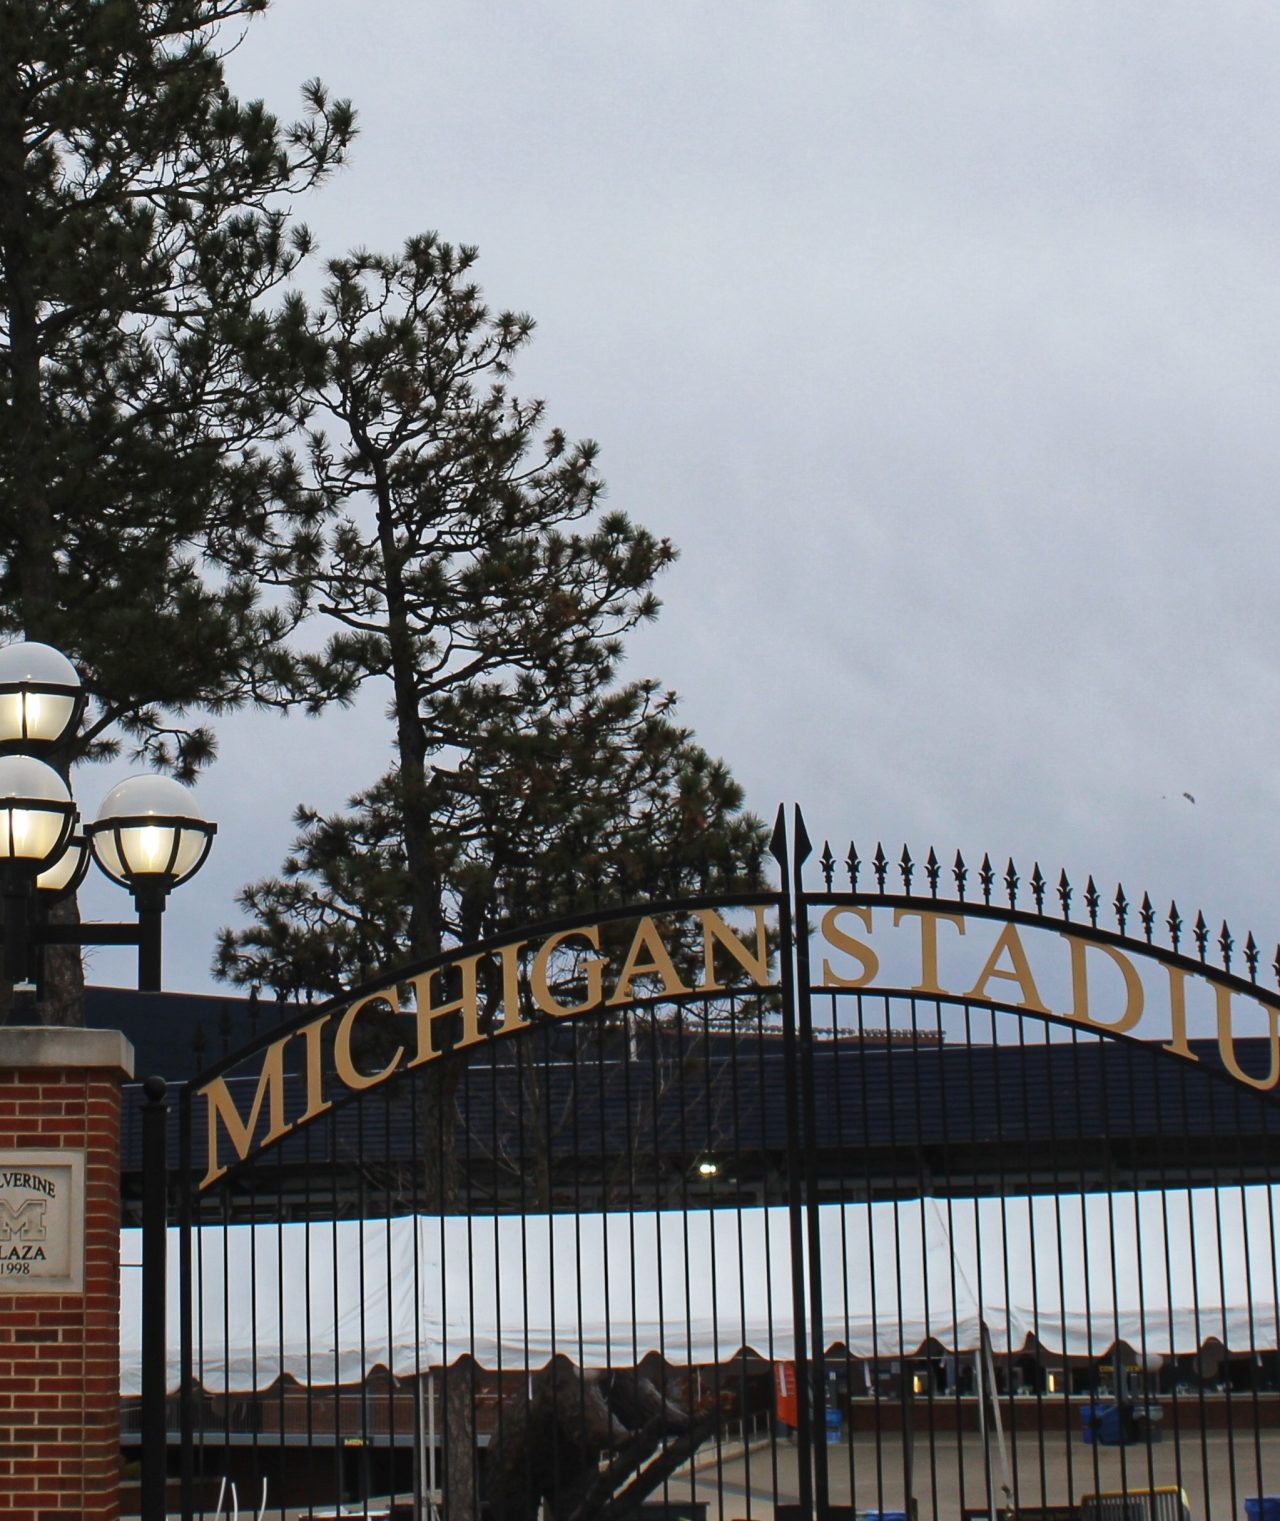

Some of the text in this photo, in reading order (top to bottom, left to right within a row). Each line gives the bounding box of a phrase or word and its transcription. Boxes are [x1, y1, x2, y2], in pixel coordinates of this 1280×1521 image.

[197, 903, 1280, 1192] MICHIGAN STADIU
[0, 1262, 31, 1276] 1998
